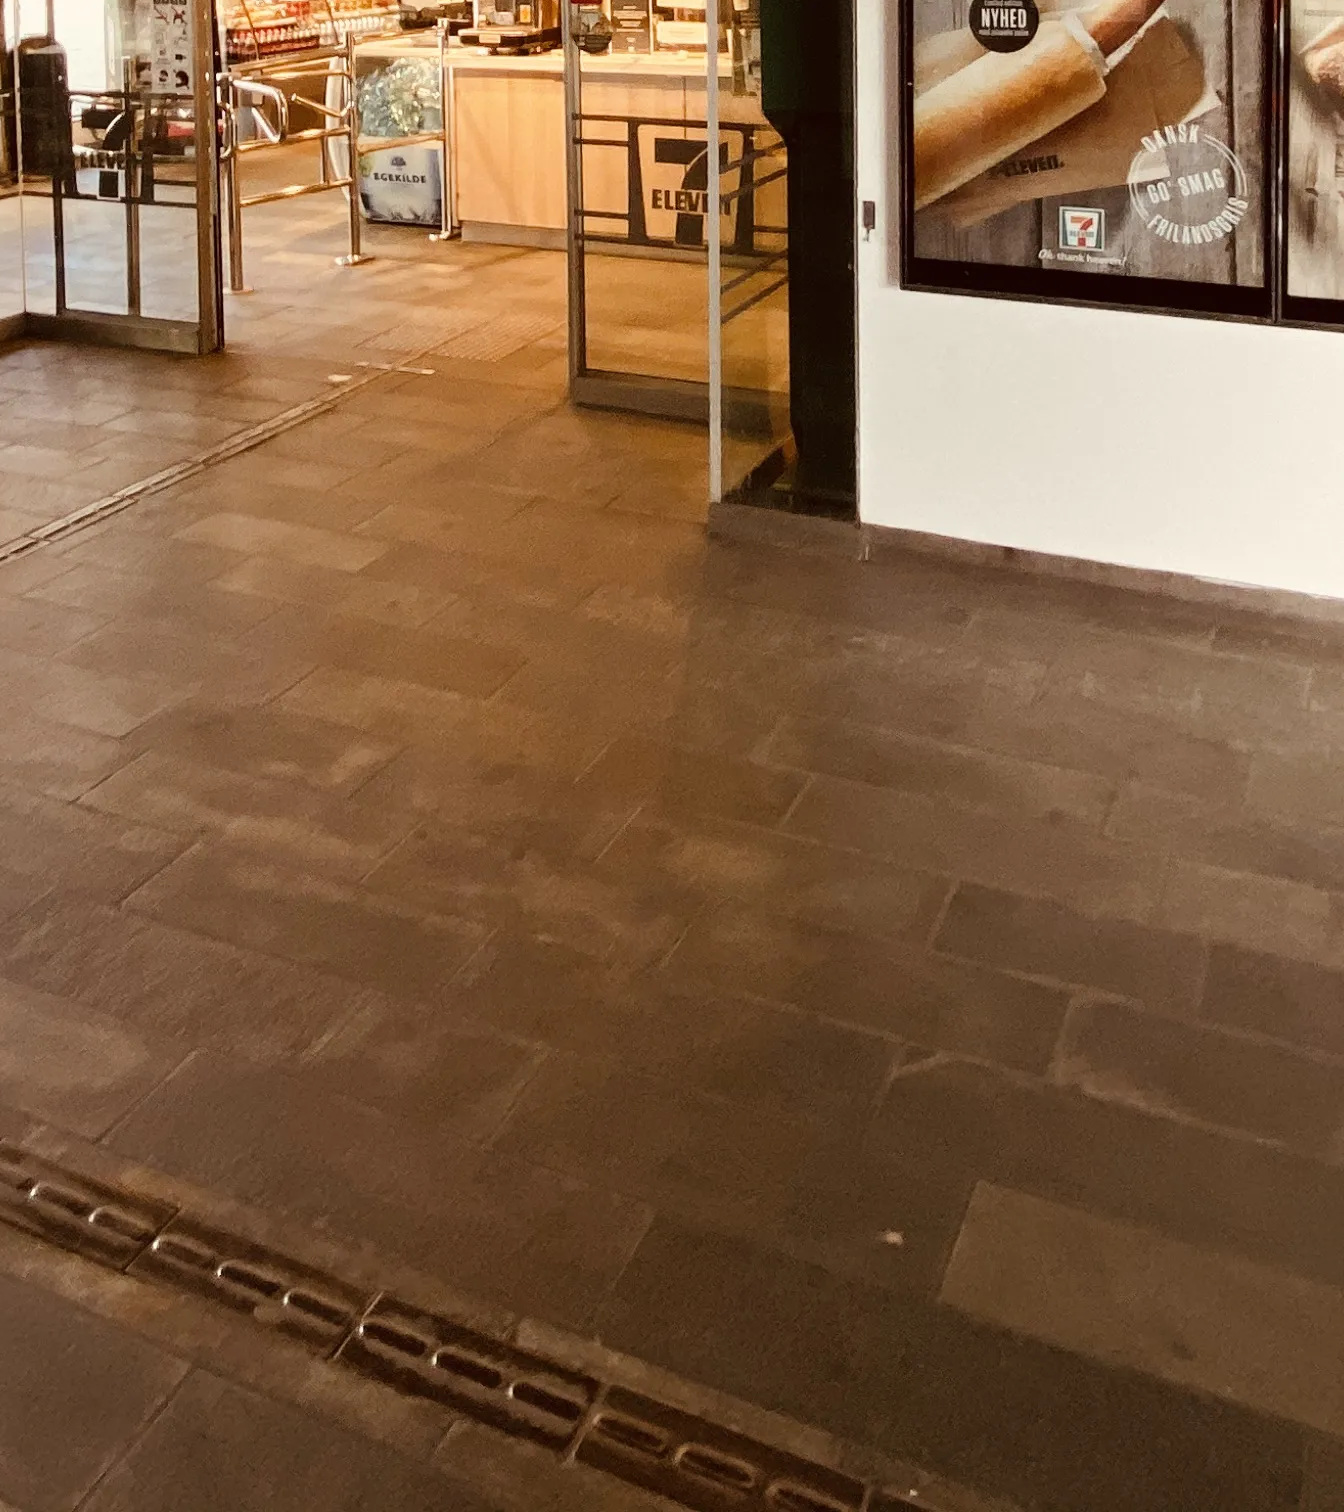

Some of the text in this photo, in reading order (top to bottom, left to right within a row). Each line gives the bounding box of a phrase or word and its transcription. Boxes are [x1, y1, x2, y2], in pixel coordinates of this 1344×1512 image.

[981, 8, 1027, 29] NYHED
[1140, 123, 1201, 153] DANSK
[373, 172, 427, 184] EGEKILDE
[654, 137, 729, 245] 7
[1177, 167, 1226, 194] SMAG
[1070, 215, 1094, 248] 7
[1146, 195, 1250, 245] FRILANDSGRIS
